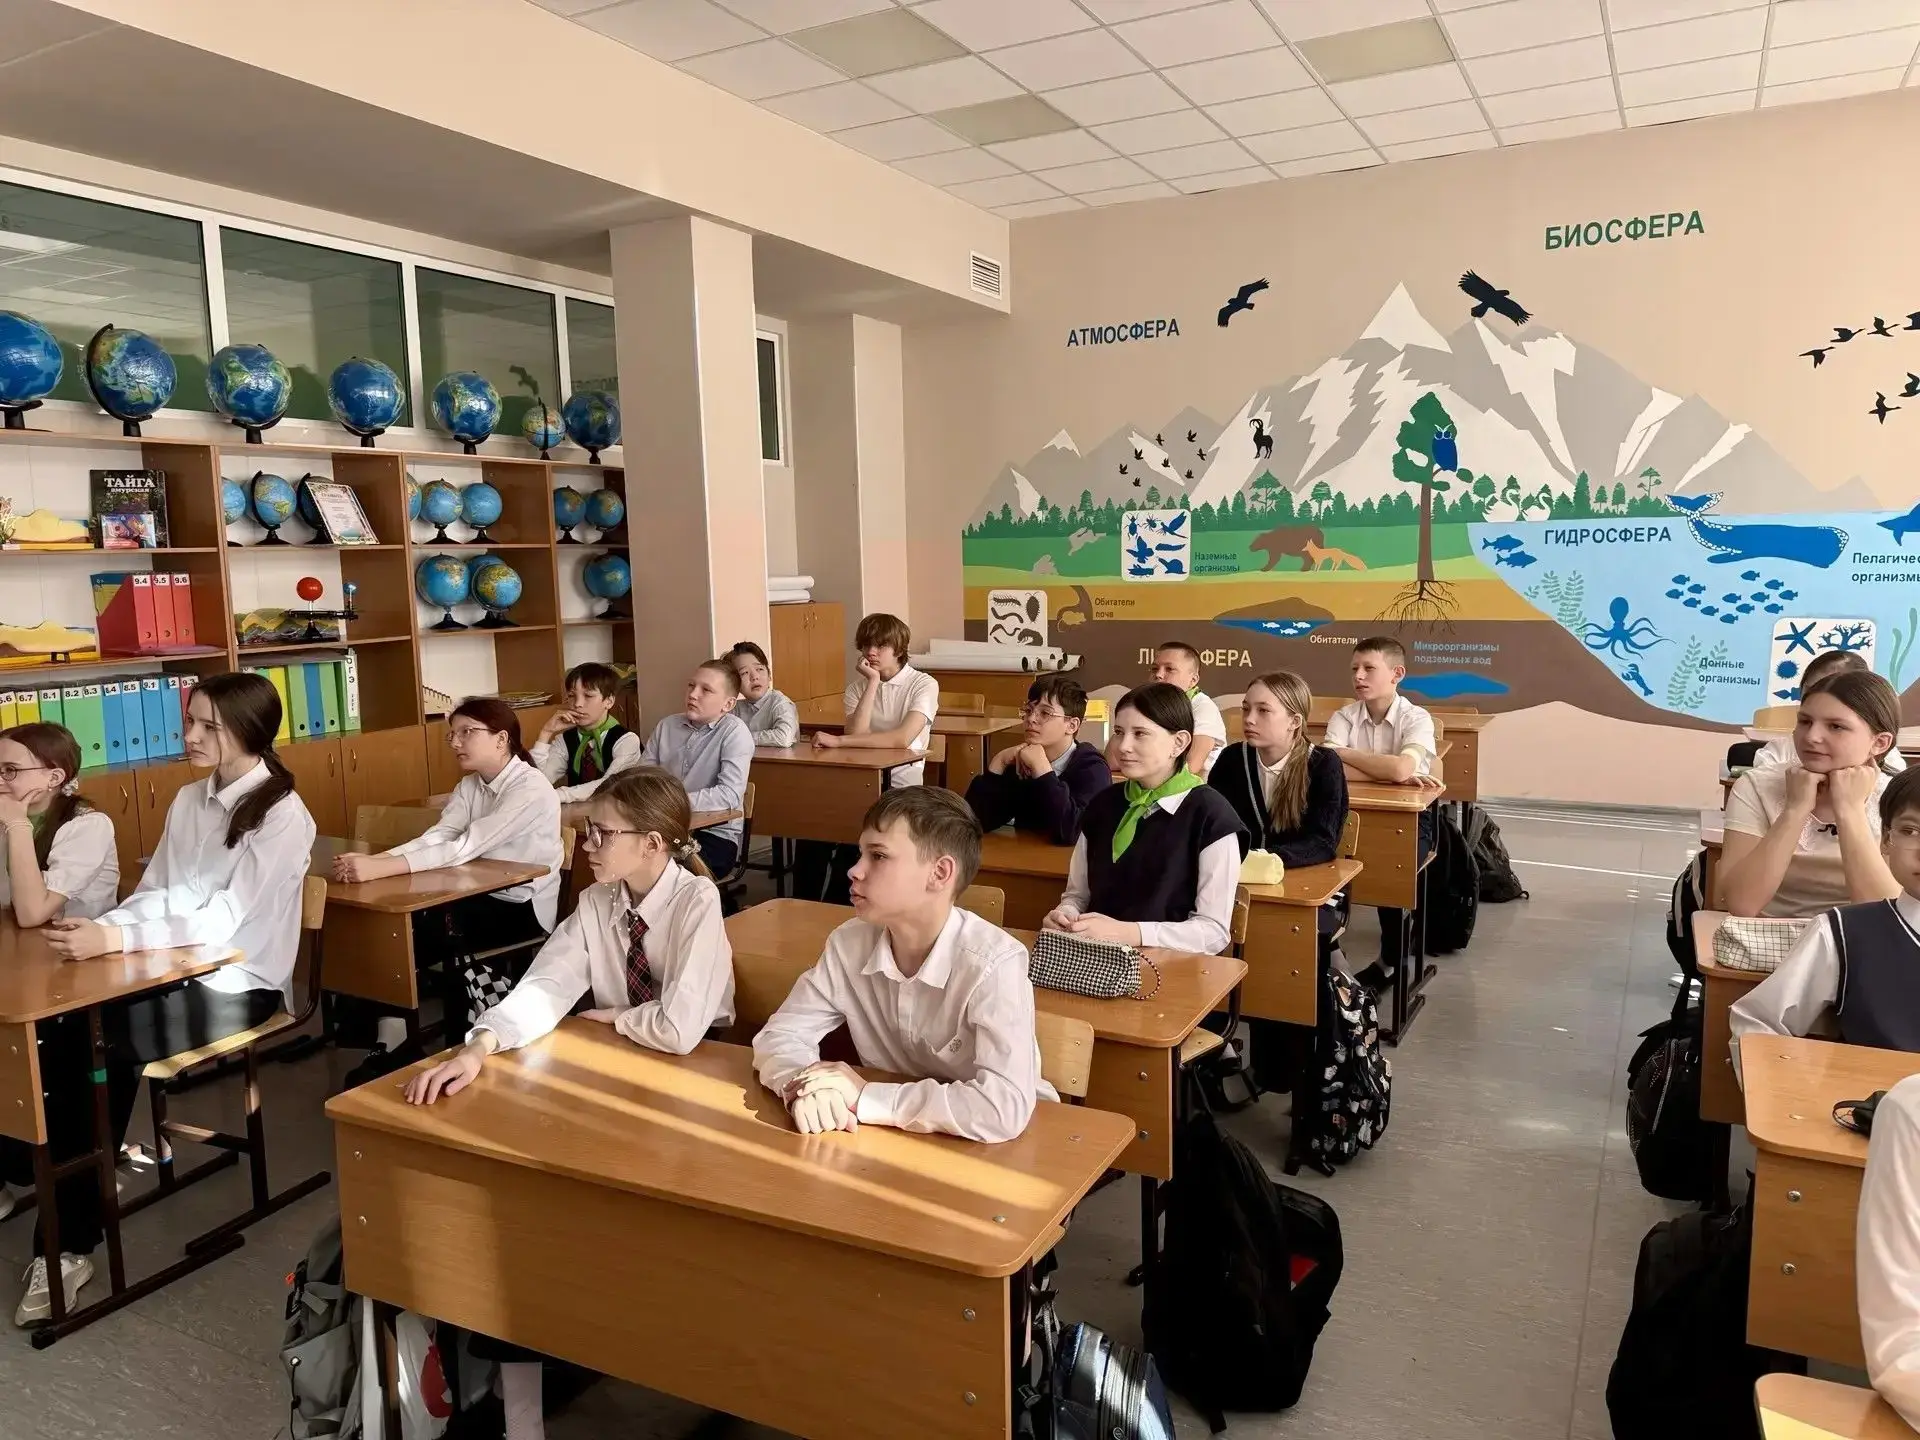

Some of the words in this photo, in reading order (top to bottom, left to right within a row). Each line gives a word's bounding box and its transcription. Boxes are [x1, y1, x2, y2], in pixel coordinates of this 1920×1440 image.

[1545, 210, 1705, 250] БИОСФЕРА
[1067, 318, 1180, 347] АТМОСФЕРА
[104, 474, 156, 488] ТАЙГА
[1544, 526, 1672, 547] ГИДРОСФЕРА
[1194, 552, 1237, 560] Наземные
[1194, 565, 1240, 573] организмы
[174, 576, 188, 584] 9.6
[1094, 598, 1135, 606] Обитатели
[1309, 635, 1358, 645] Обитатели
[1414, 641, 1500, 652] Микроорганизмы
[1138, 648, 1253, 667] ЛФЕРА
[1414, 655, 1470, 664] подземных
[1473, 656, 1491, 665] вод
[1699, 657, 1745, 669] Донные
[1698, 674, 1760, 685] организмы
[123, 683, 137, 691] 8.5
[143, 681, 156, 689] 9.1
[83, 687, 98, 695] 8.3
[18, 694, 33, 702] 6.7
